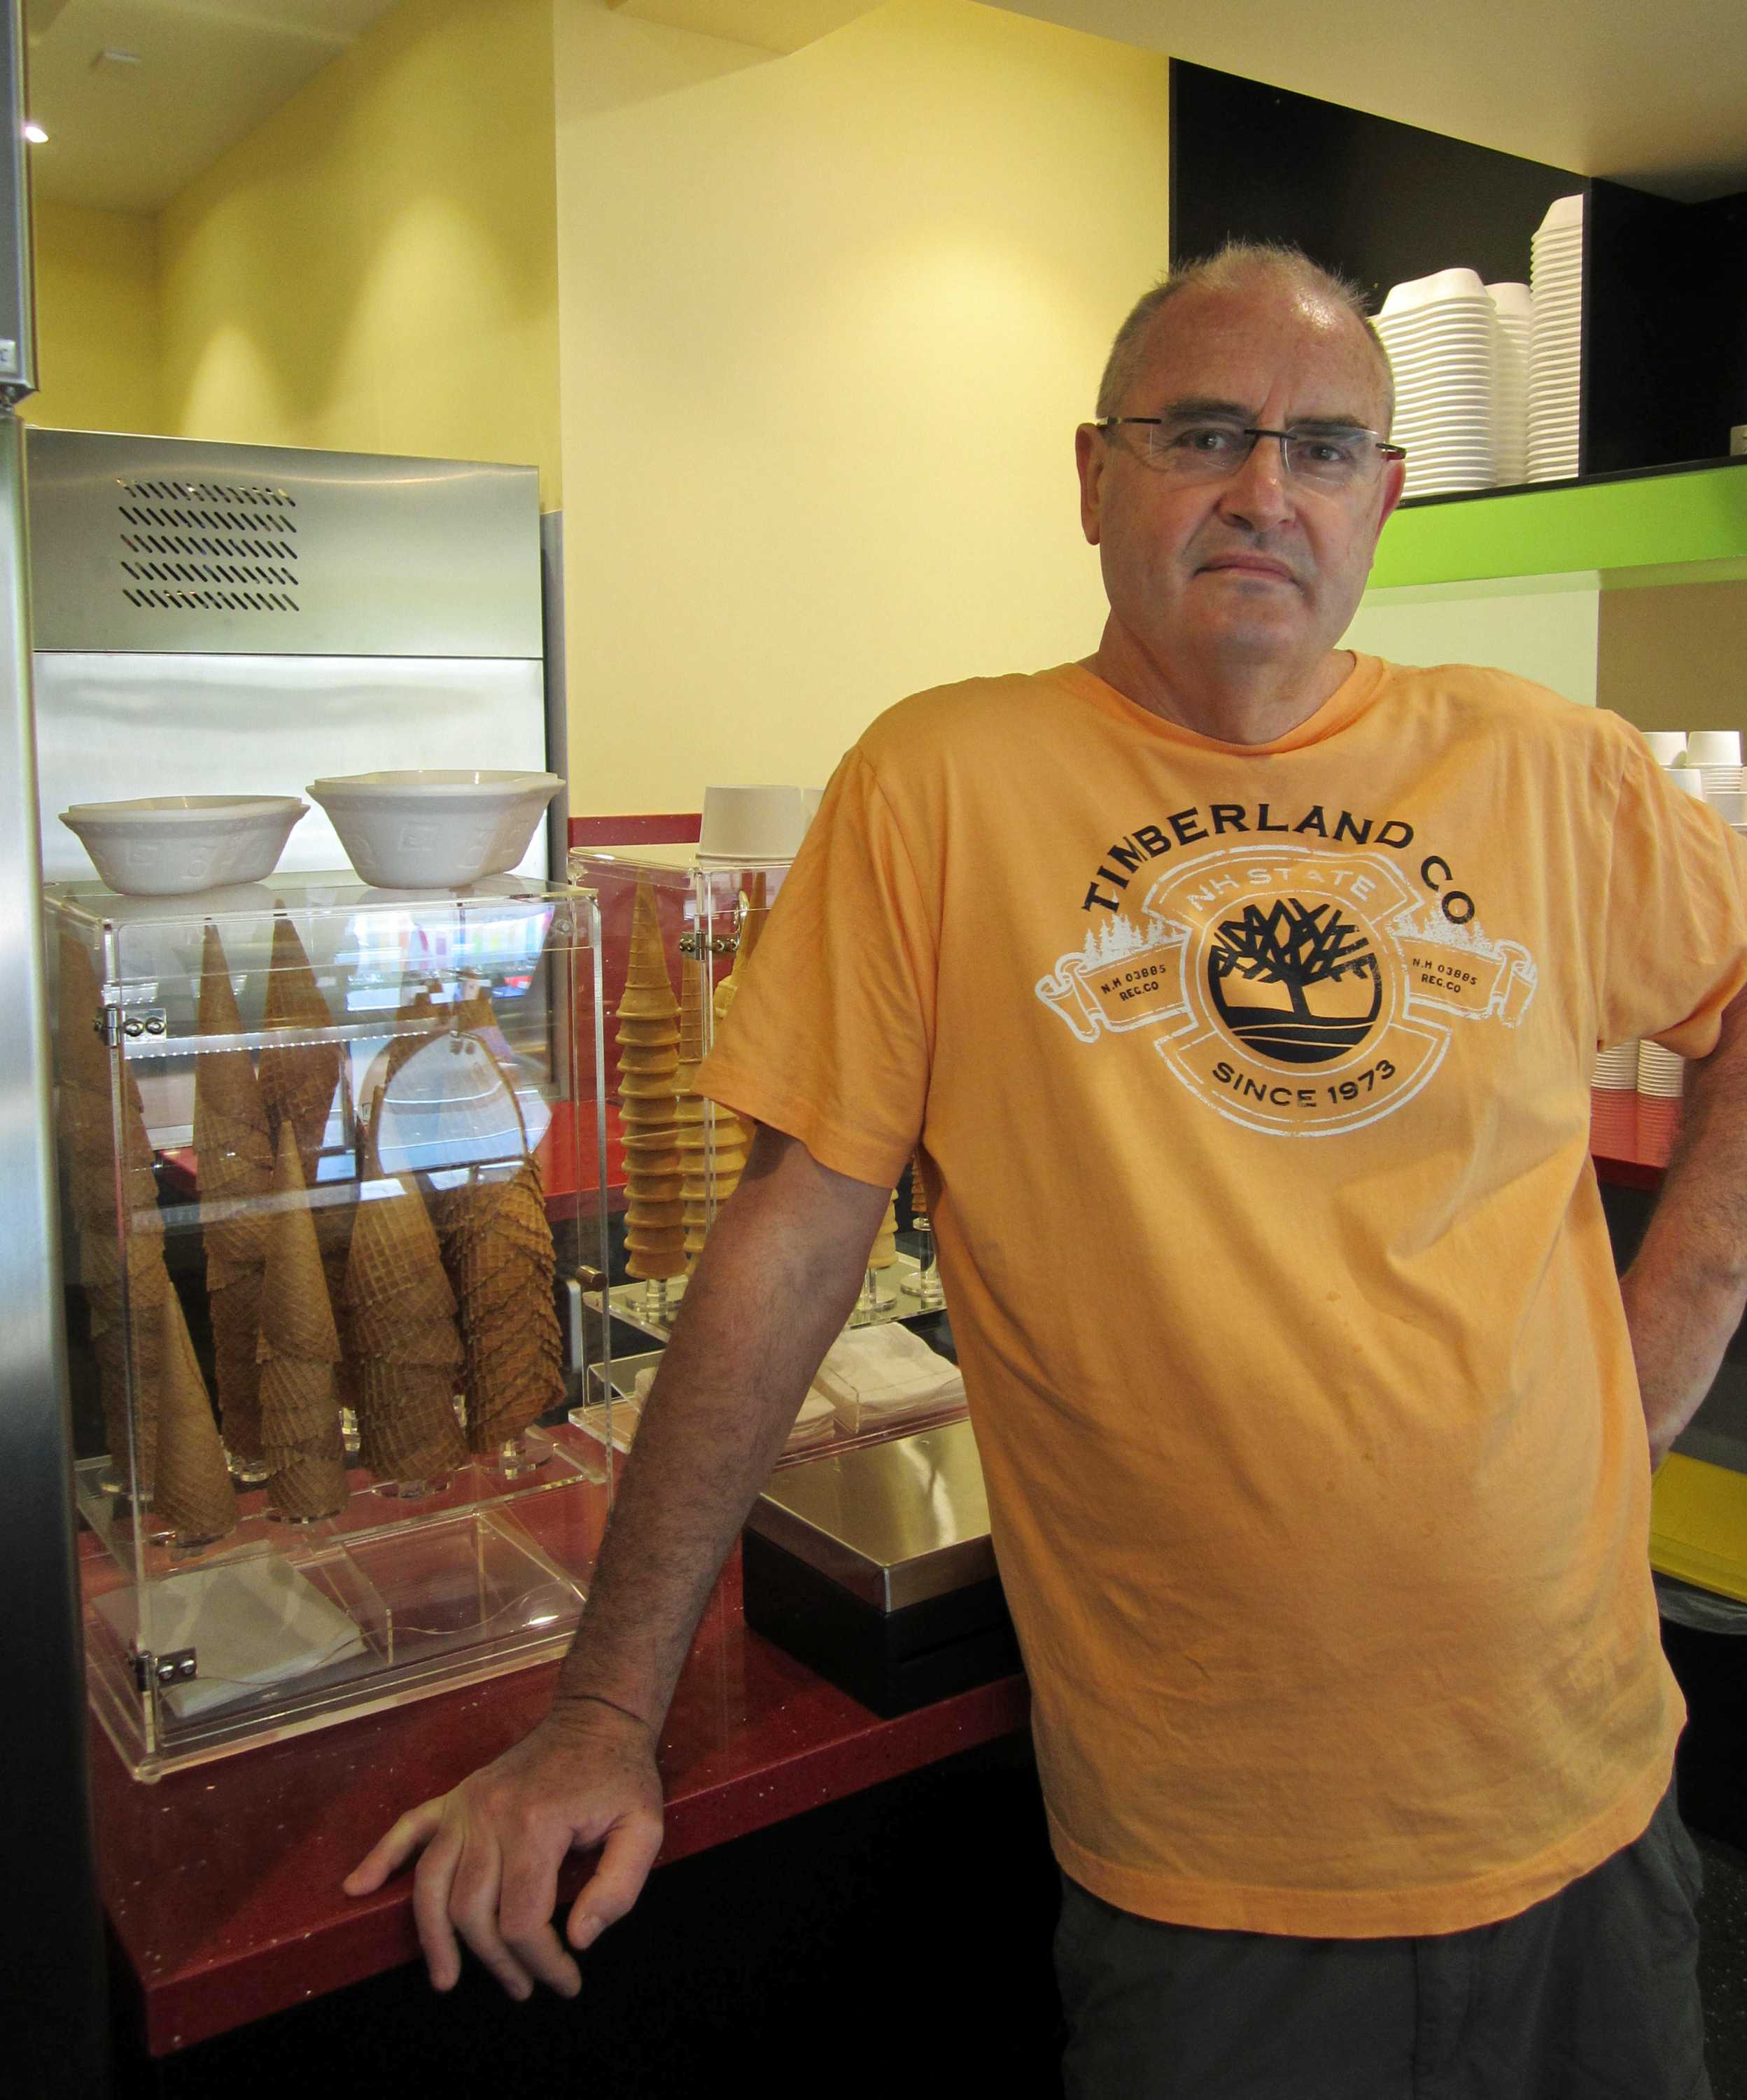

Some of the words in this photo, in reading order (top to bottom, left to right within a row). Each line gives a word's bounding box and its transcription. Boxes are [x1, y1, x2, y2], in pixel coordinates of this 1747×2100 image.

[1081, 803, 1414, 913] TIMBERLAND
[1421, 855, 1475, 924] CO
[1187, 874, 1240, 911] NH
[1247, 867, 1377, 902] STATE
[1212, 1061, 1317, 1107] SINCE
[1327, 1059, 1396, 1104] 1973
